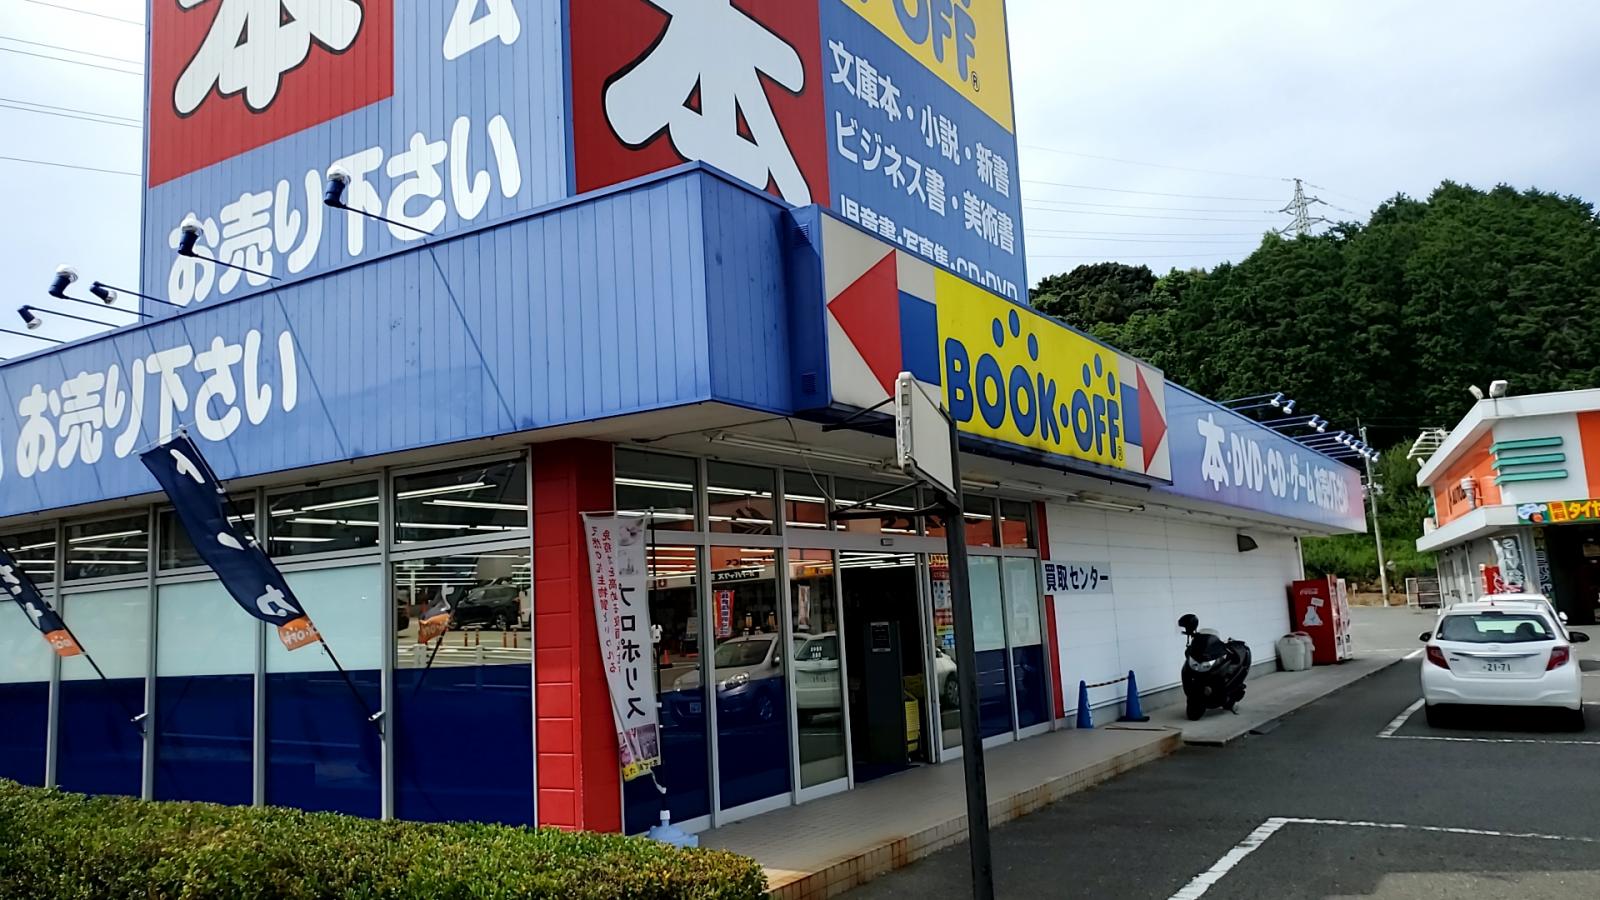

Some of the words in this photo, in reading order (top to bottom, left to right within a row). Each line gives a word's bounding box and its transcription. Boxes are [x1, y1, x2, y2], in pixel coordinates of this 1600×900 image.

[168, 114, 522, 308] お売り下さい
[835, 110, 1016, 256] ビジネス書・美術書
[16, 329, 298, 479] お売り下さい
[1044, 563, 1109, 592] 買取センター
